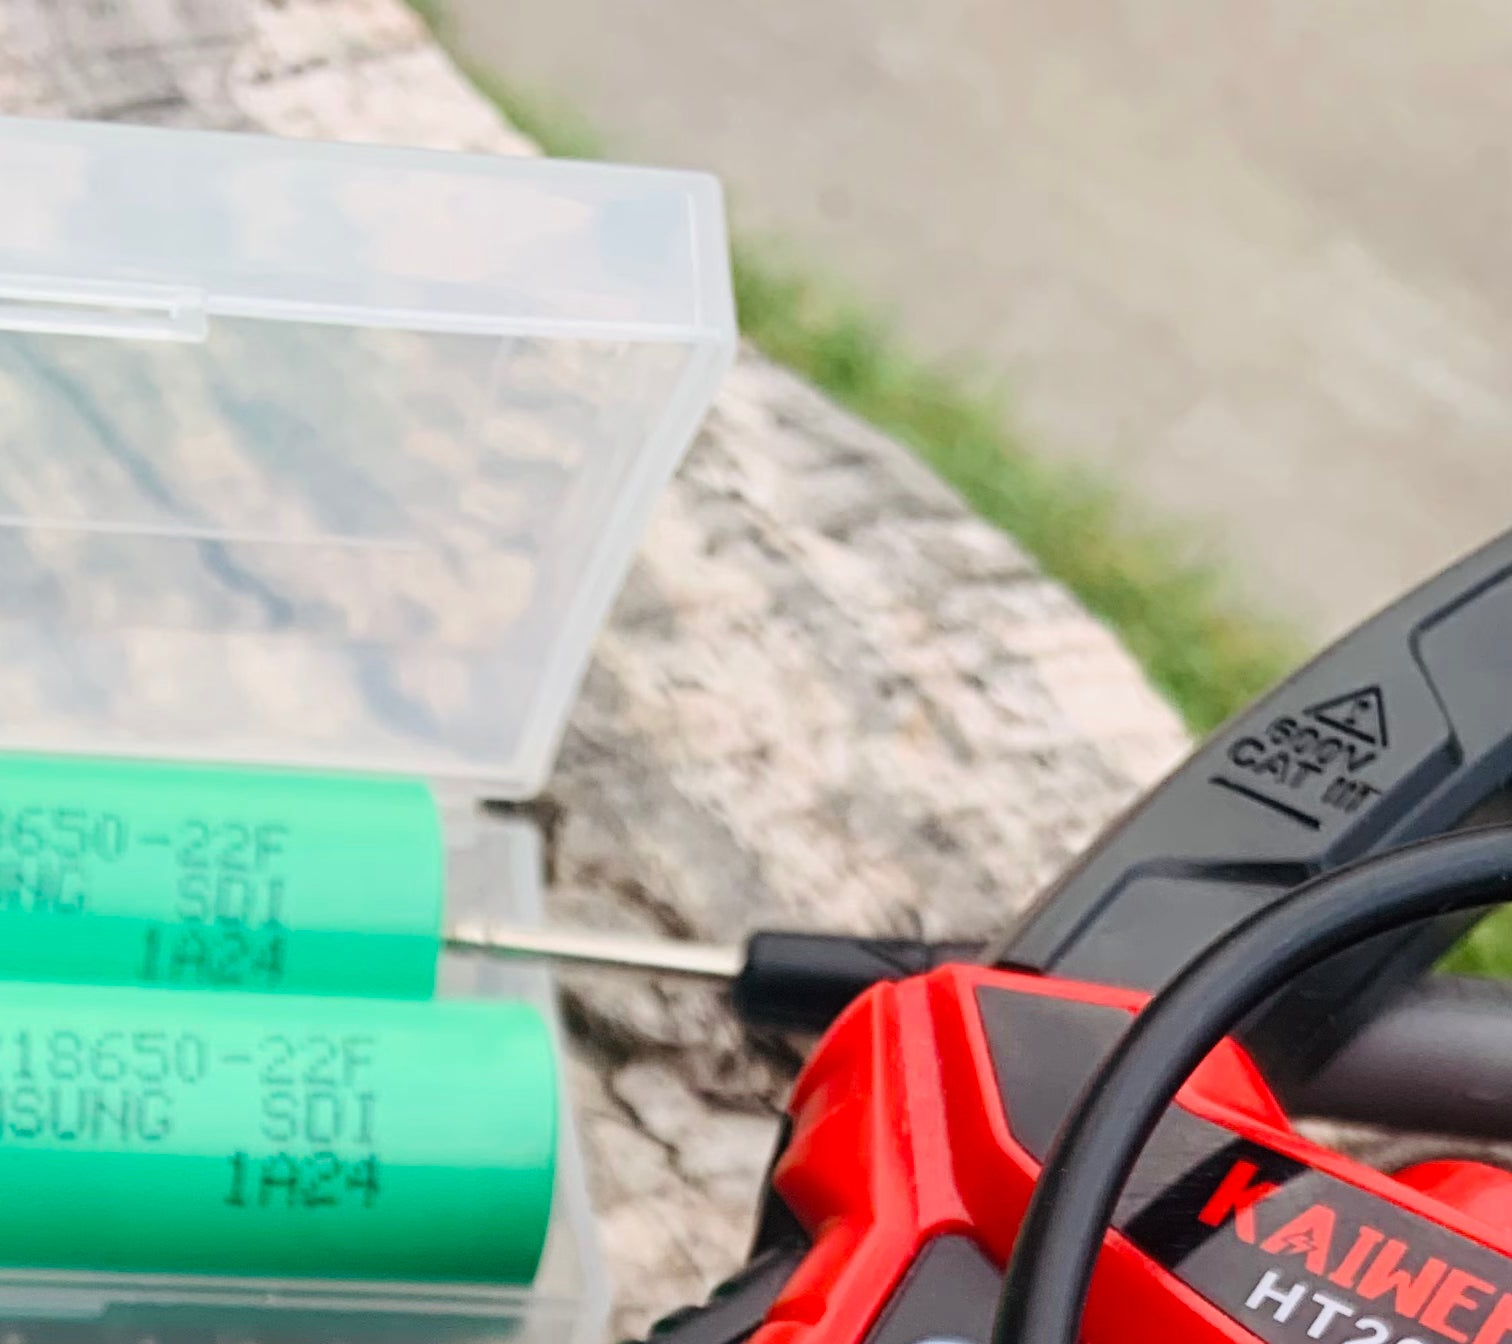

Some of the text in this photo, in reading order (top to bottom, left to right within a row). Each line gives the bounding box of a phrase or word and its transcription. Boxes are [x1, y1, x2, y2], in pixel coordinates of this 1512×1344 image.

[1227, 737, 1323, 788] CAT
[176, 875, 287, 929] SDI
[136, 926, 287, 985] 1A24
[259, 1091, 377, 1146] SDI
[223, 1151, 381, 1208] 1A24
